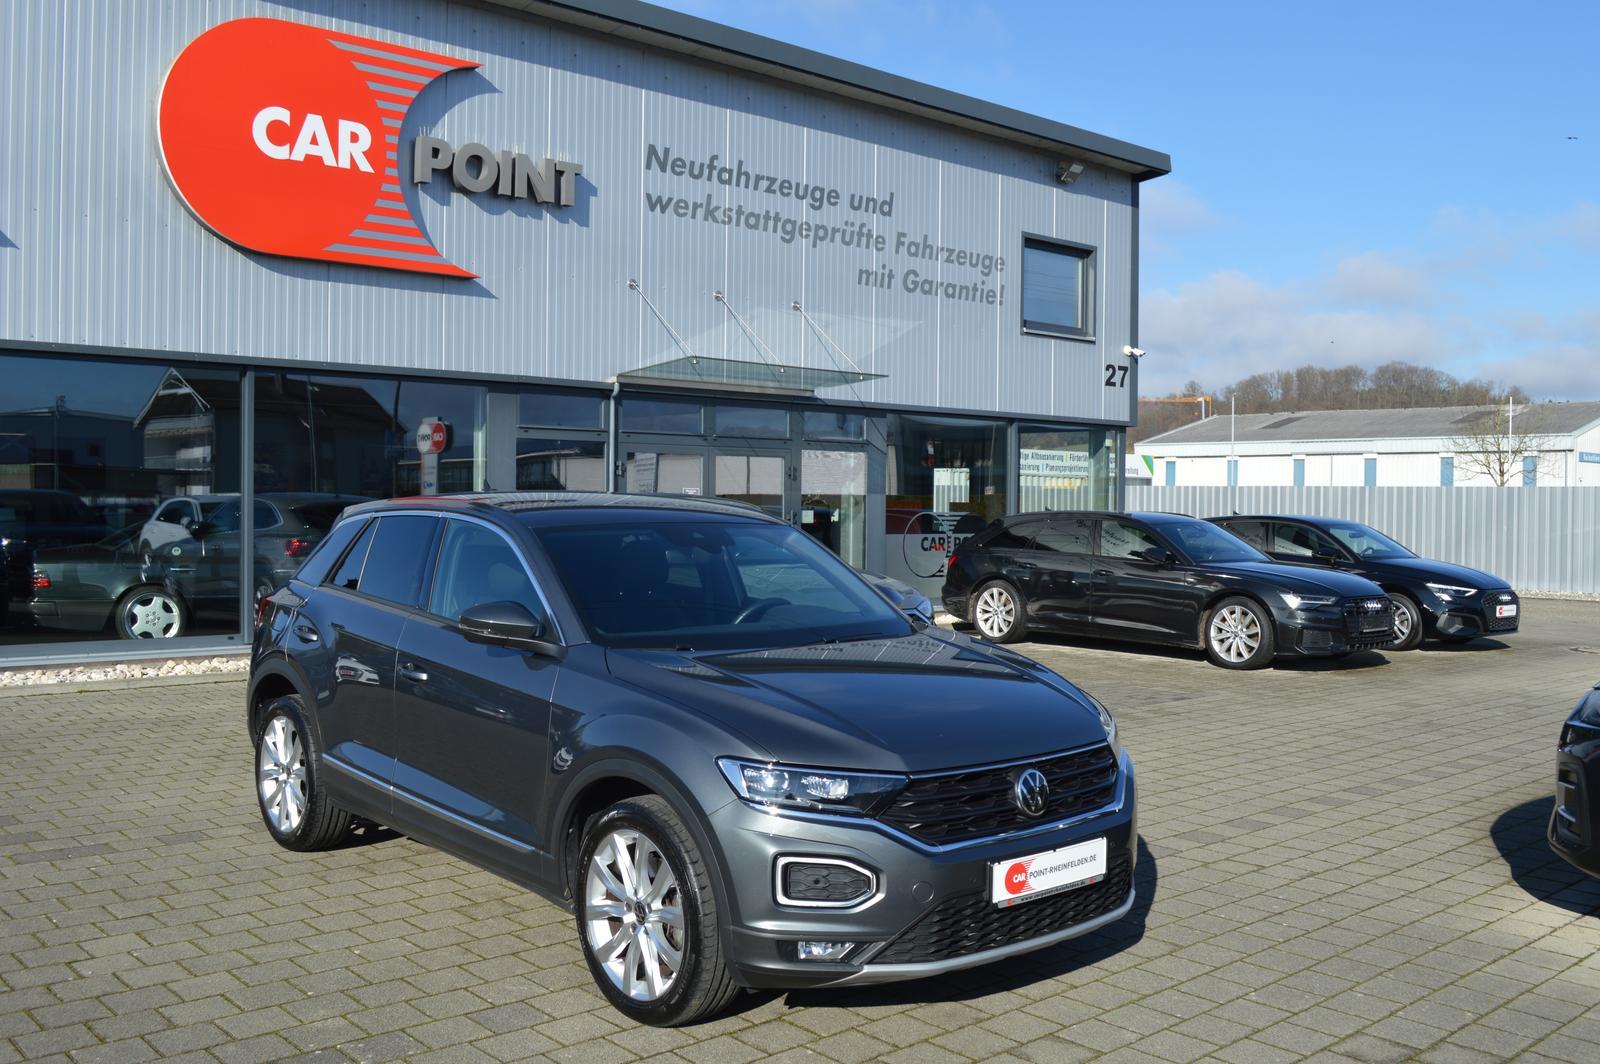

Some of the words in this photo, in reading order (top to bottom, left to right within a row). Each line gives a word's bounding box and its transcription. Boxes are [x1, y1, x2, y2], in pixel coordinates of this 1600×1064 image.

[252, 106, 375, 173] CAR
[413, 136, 583, 206] POINT
[645, 144, 840, 211] Neufahrzeuge
[849, 191, 895, 217] und
[645, 192, 887, 252] werkstattgeprüfte
[894, 231, 1006, 277] Fahrzeuge
[857, 263, 895, 290] mit
[902, 268, 1006, 306] Garantie!
[1104, 364, 1129, 388] 27
[920, 536, 946, 552] CAR
[1012, 872, 1027, 884] CAR
[1029, 854, 1097, 880] POINT-RHEINFELDEN.DE
